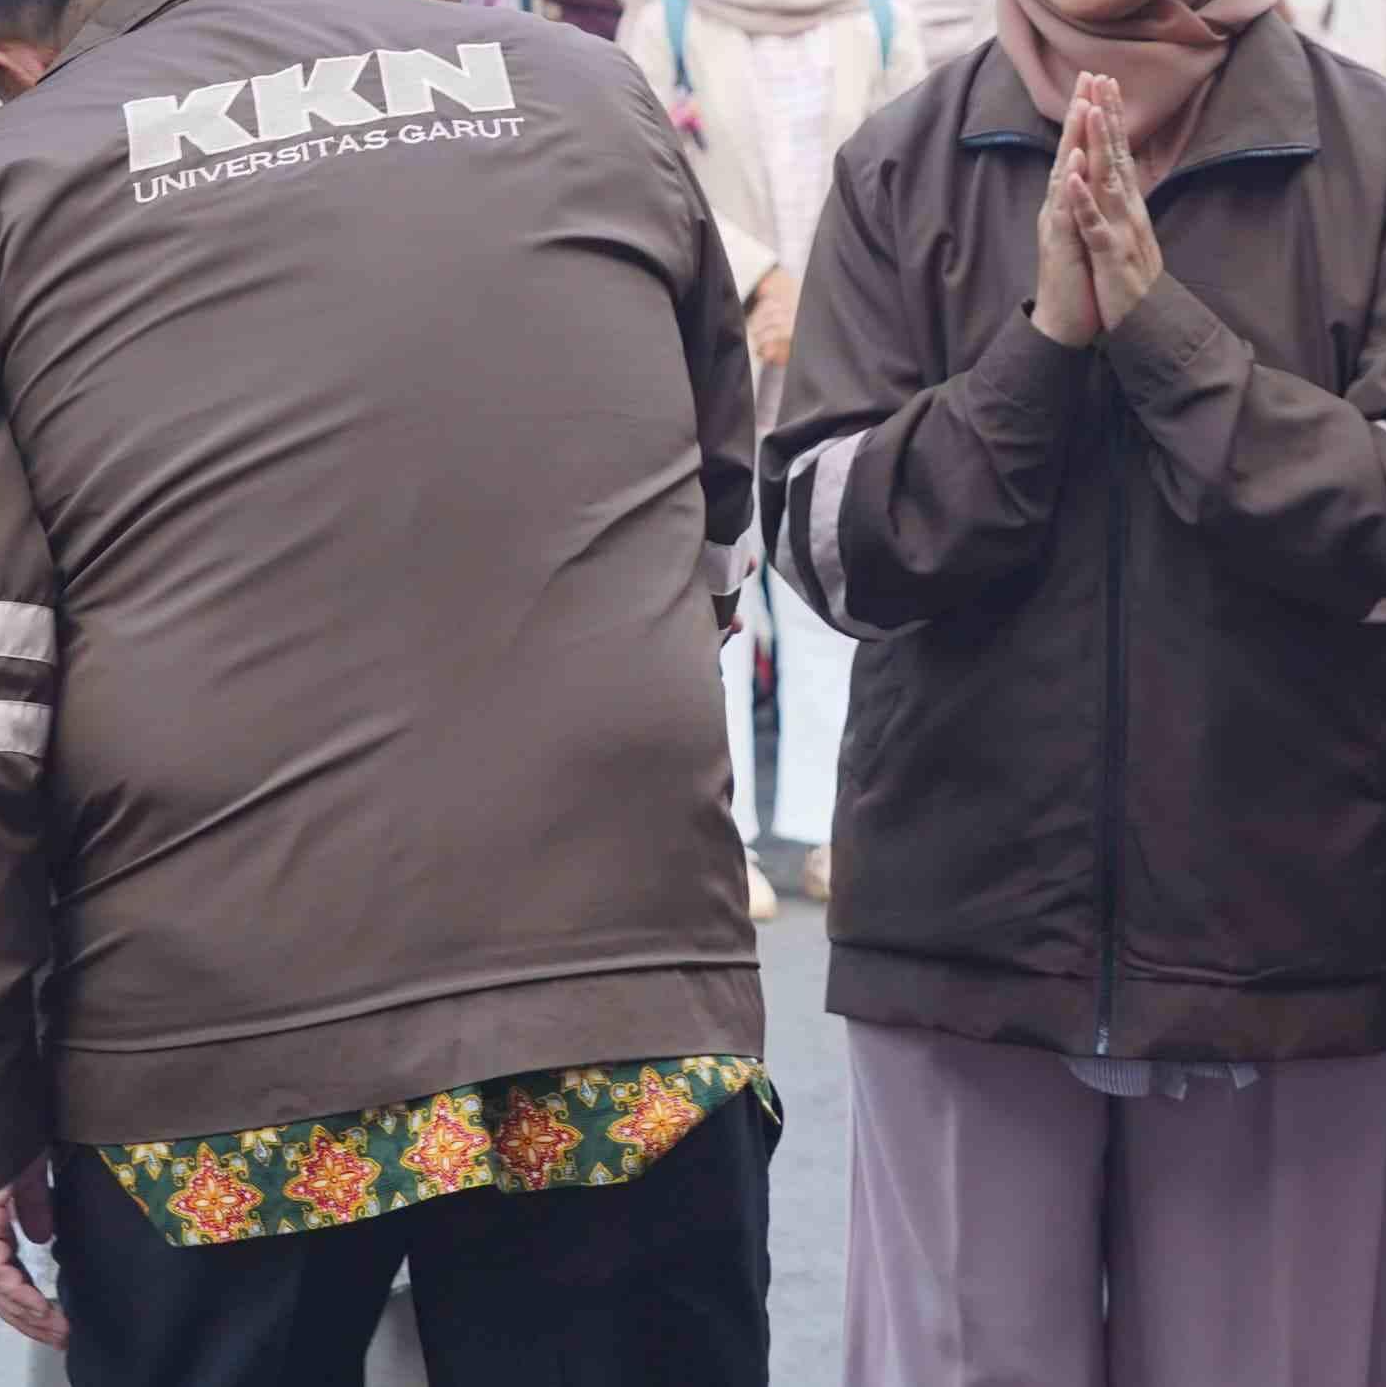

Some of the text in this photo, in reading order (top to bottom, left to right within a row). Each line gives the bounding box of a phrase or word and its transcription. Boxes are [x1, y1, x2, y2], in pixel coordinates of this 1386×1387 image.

[123, 42, 516, 173] KKN
[132, 117, 525, 204] UNIVERSITAS GARUT
